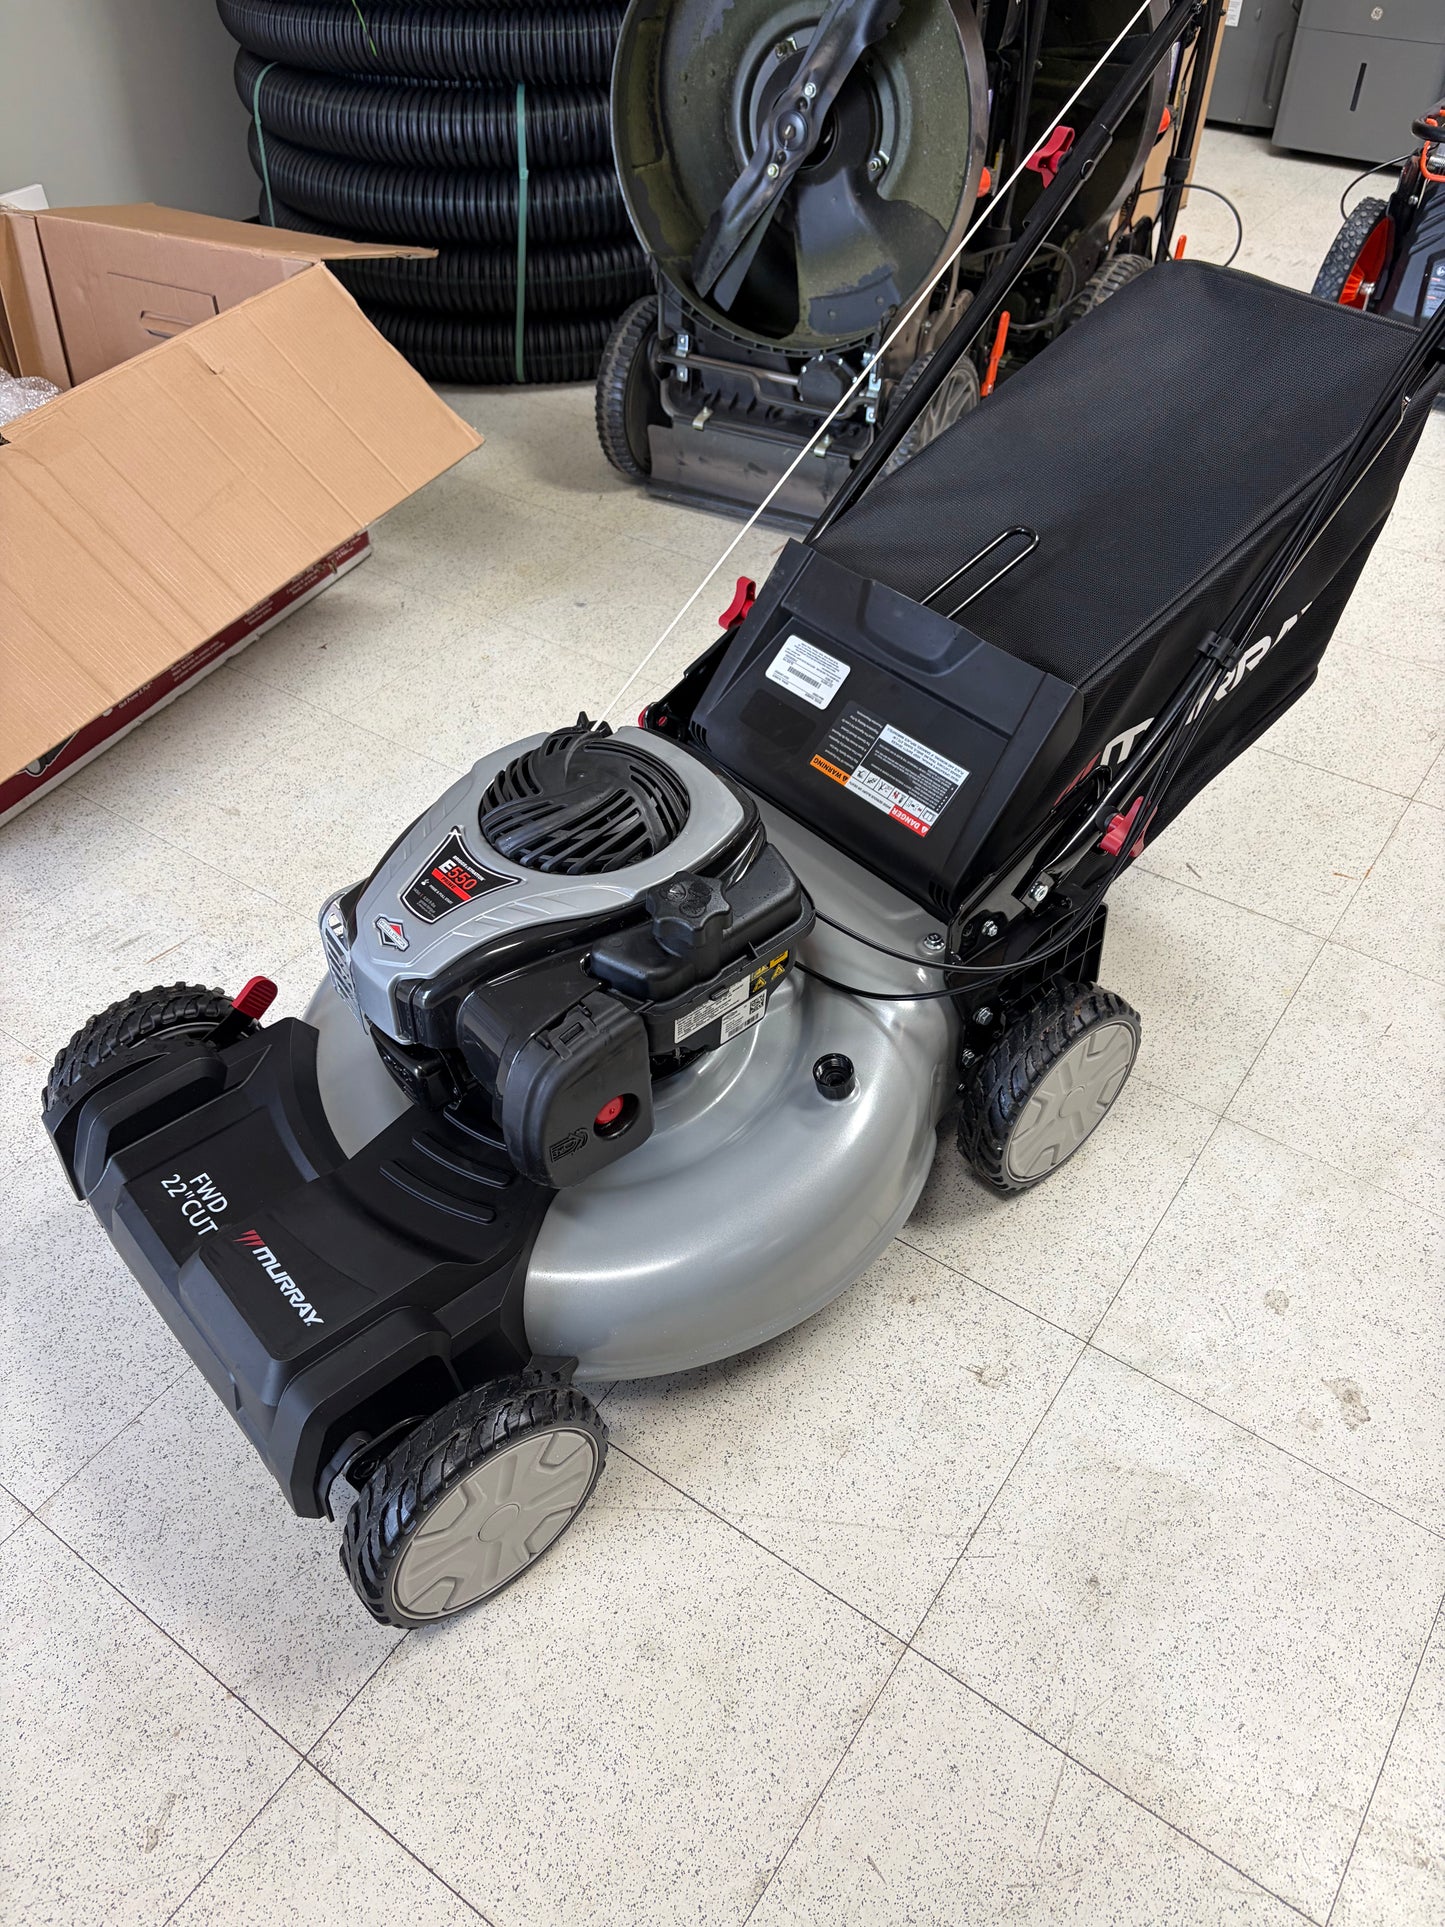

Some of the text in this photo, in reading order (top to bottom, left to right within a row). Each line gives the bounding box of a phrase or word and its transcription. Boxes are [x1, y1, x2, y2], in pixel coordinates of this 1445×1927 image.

[813, 757, 842, 778] WARNING
[890, 807, 921, 829] DANGER
[438, 859, 477, 890] E550
[441, 877, 455, 889] PRIME
[189, 1172, 228, 1213] FWD
[252, 1246, 325, 1327] MURRAY
